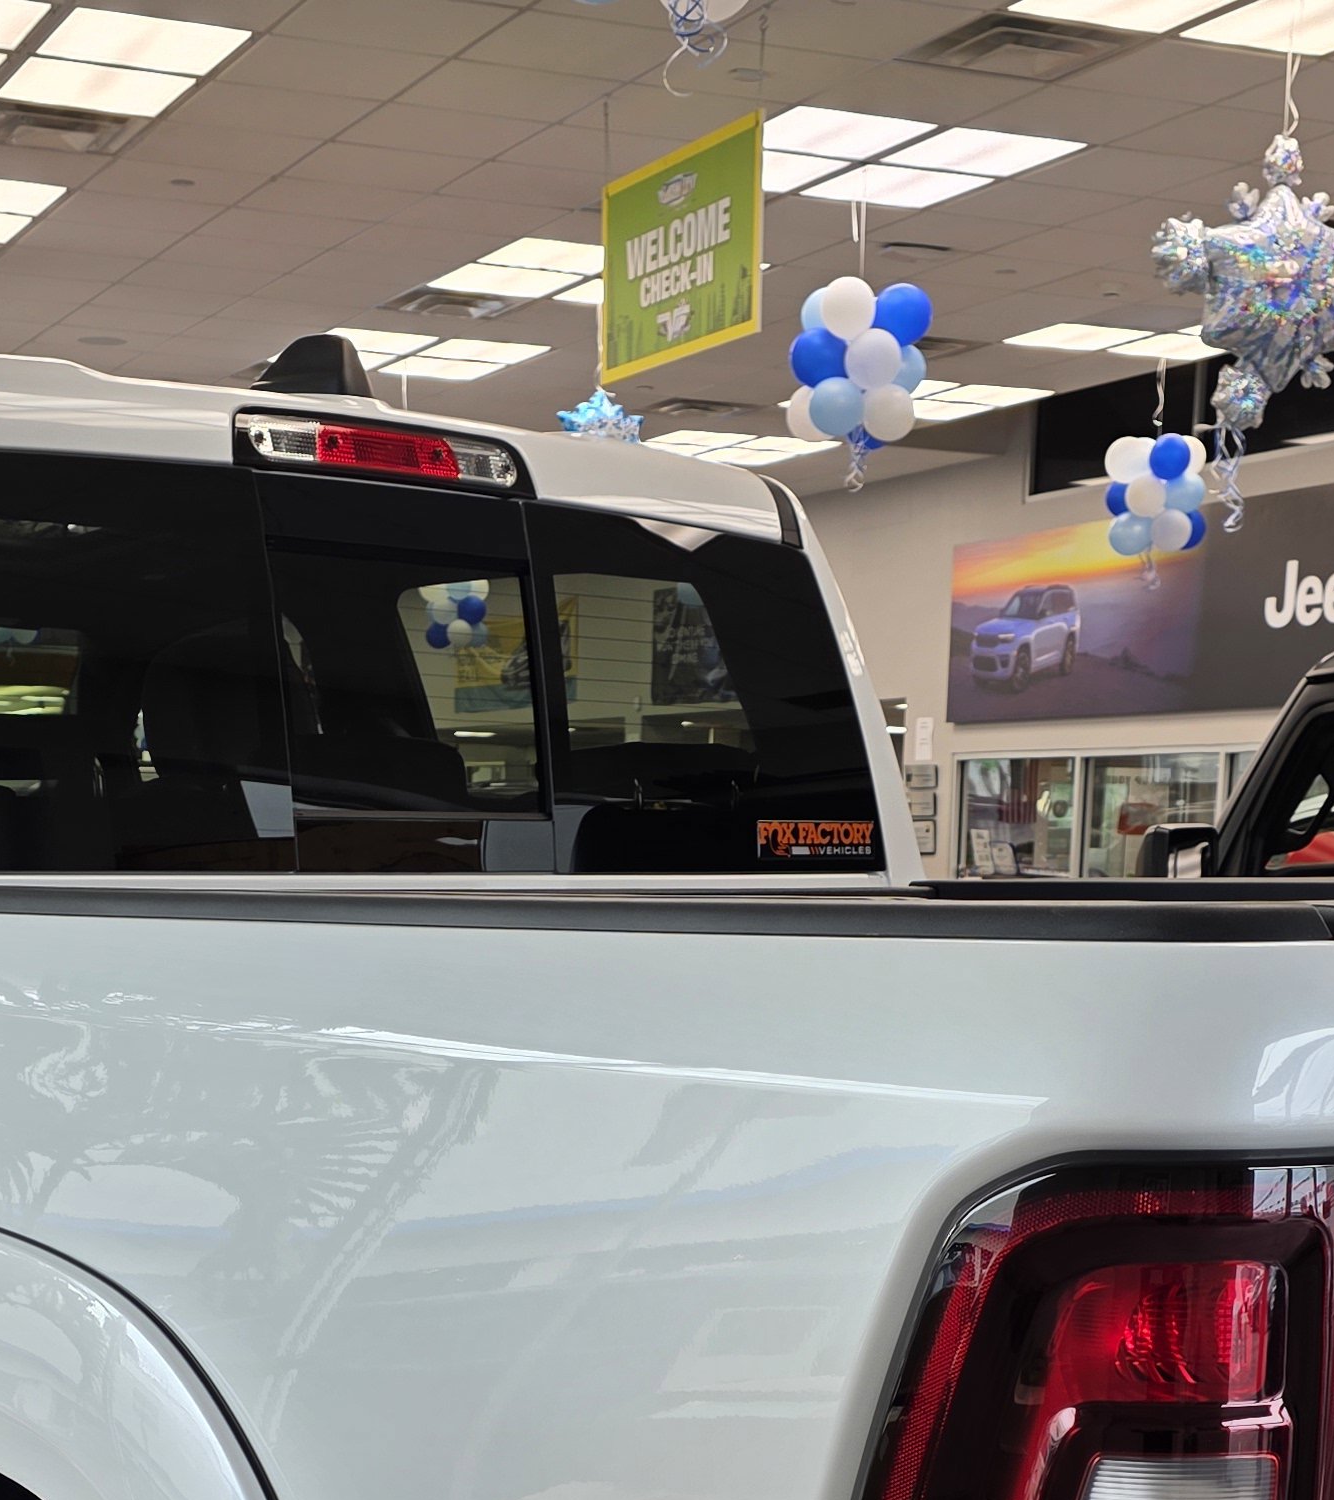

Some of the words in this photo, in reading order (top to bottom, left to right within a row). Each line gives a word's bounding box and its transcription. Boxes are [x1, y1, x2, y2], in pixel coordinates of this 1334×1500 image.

[625, 196, 732, 281] WELCOME
[639, 250, 715, 308] CHECK-IN
[759, 822, 796, 847] FOX
[798, 822, 875, 845] FACTORY
[819, 846, 872, 855] VEHICLES
